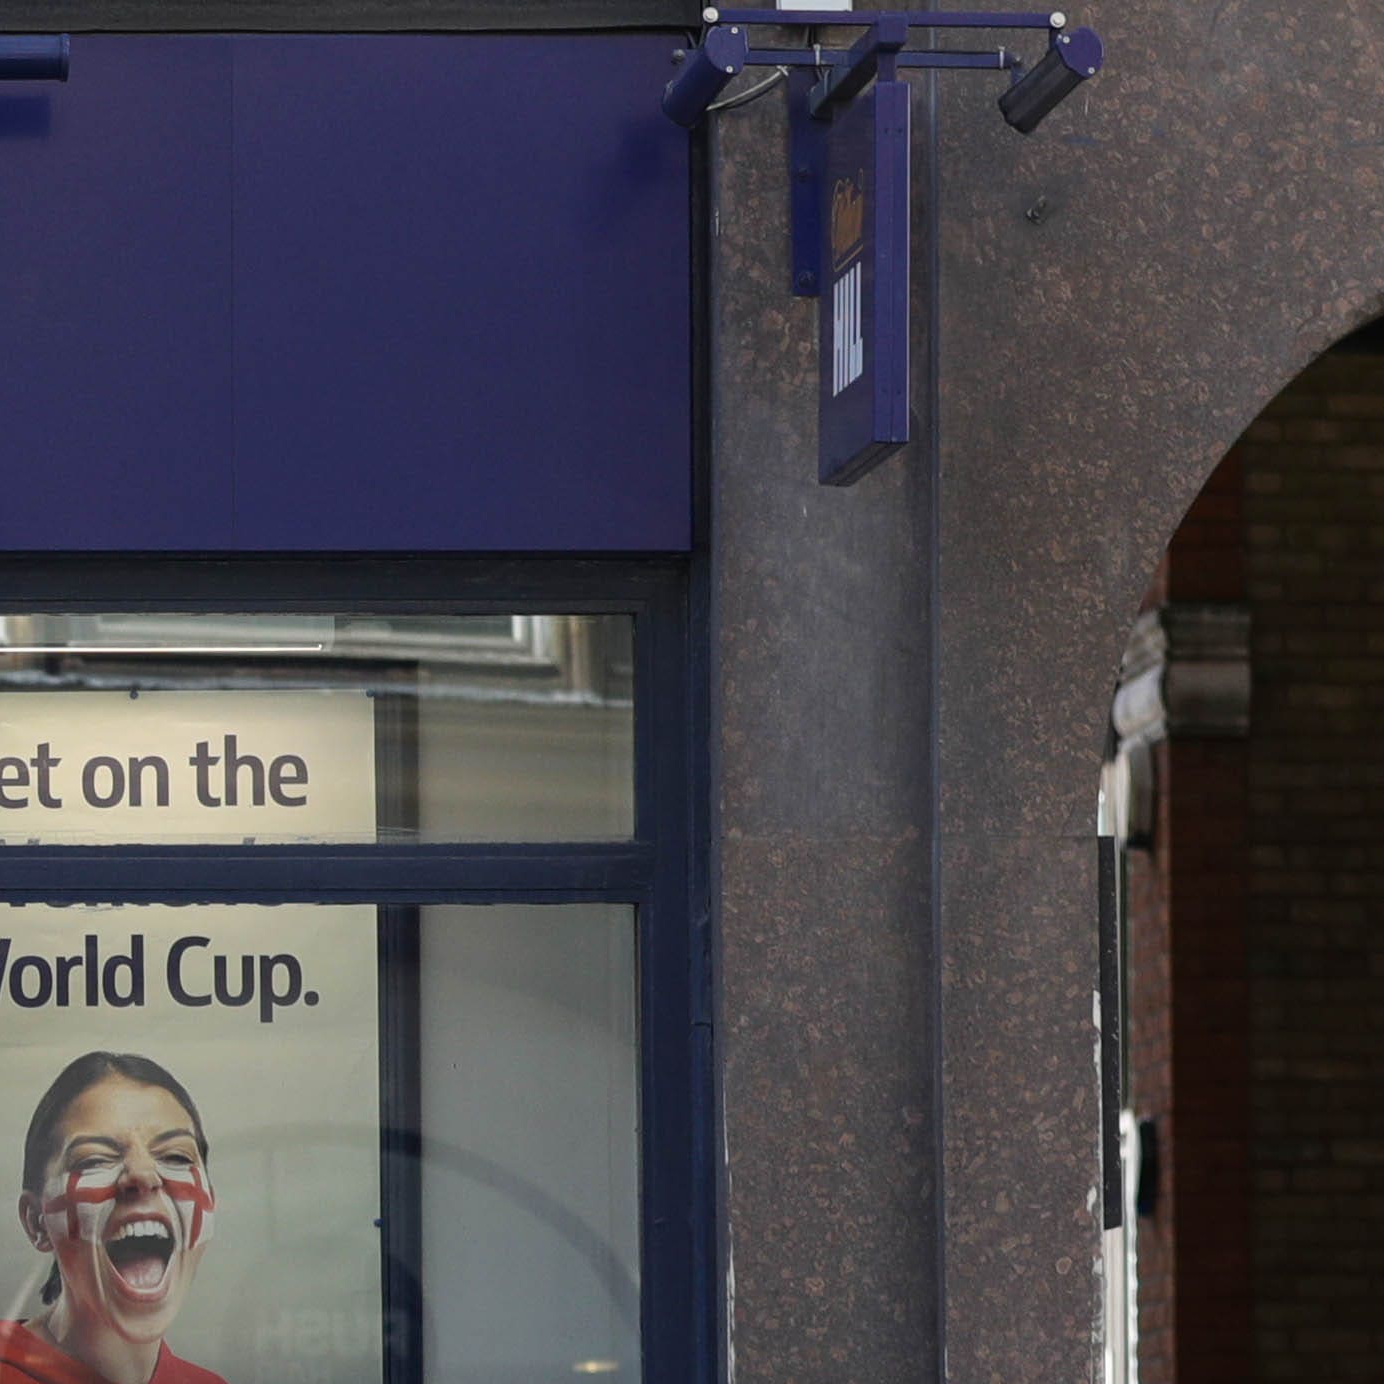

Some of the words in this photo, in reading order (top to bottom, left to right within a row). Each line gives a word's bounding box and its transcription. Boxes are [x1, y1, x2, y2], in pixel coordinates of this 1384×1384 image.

[82, 756, 170, 808] on
[188, 734, 309, 807] the
[166, 935, 321, 1023] Cup.
